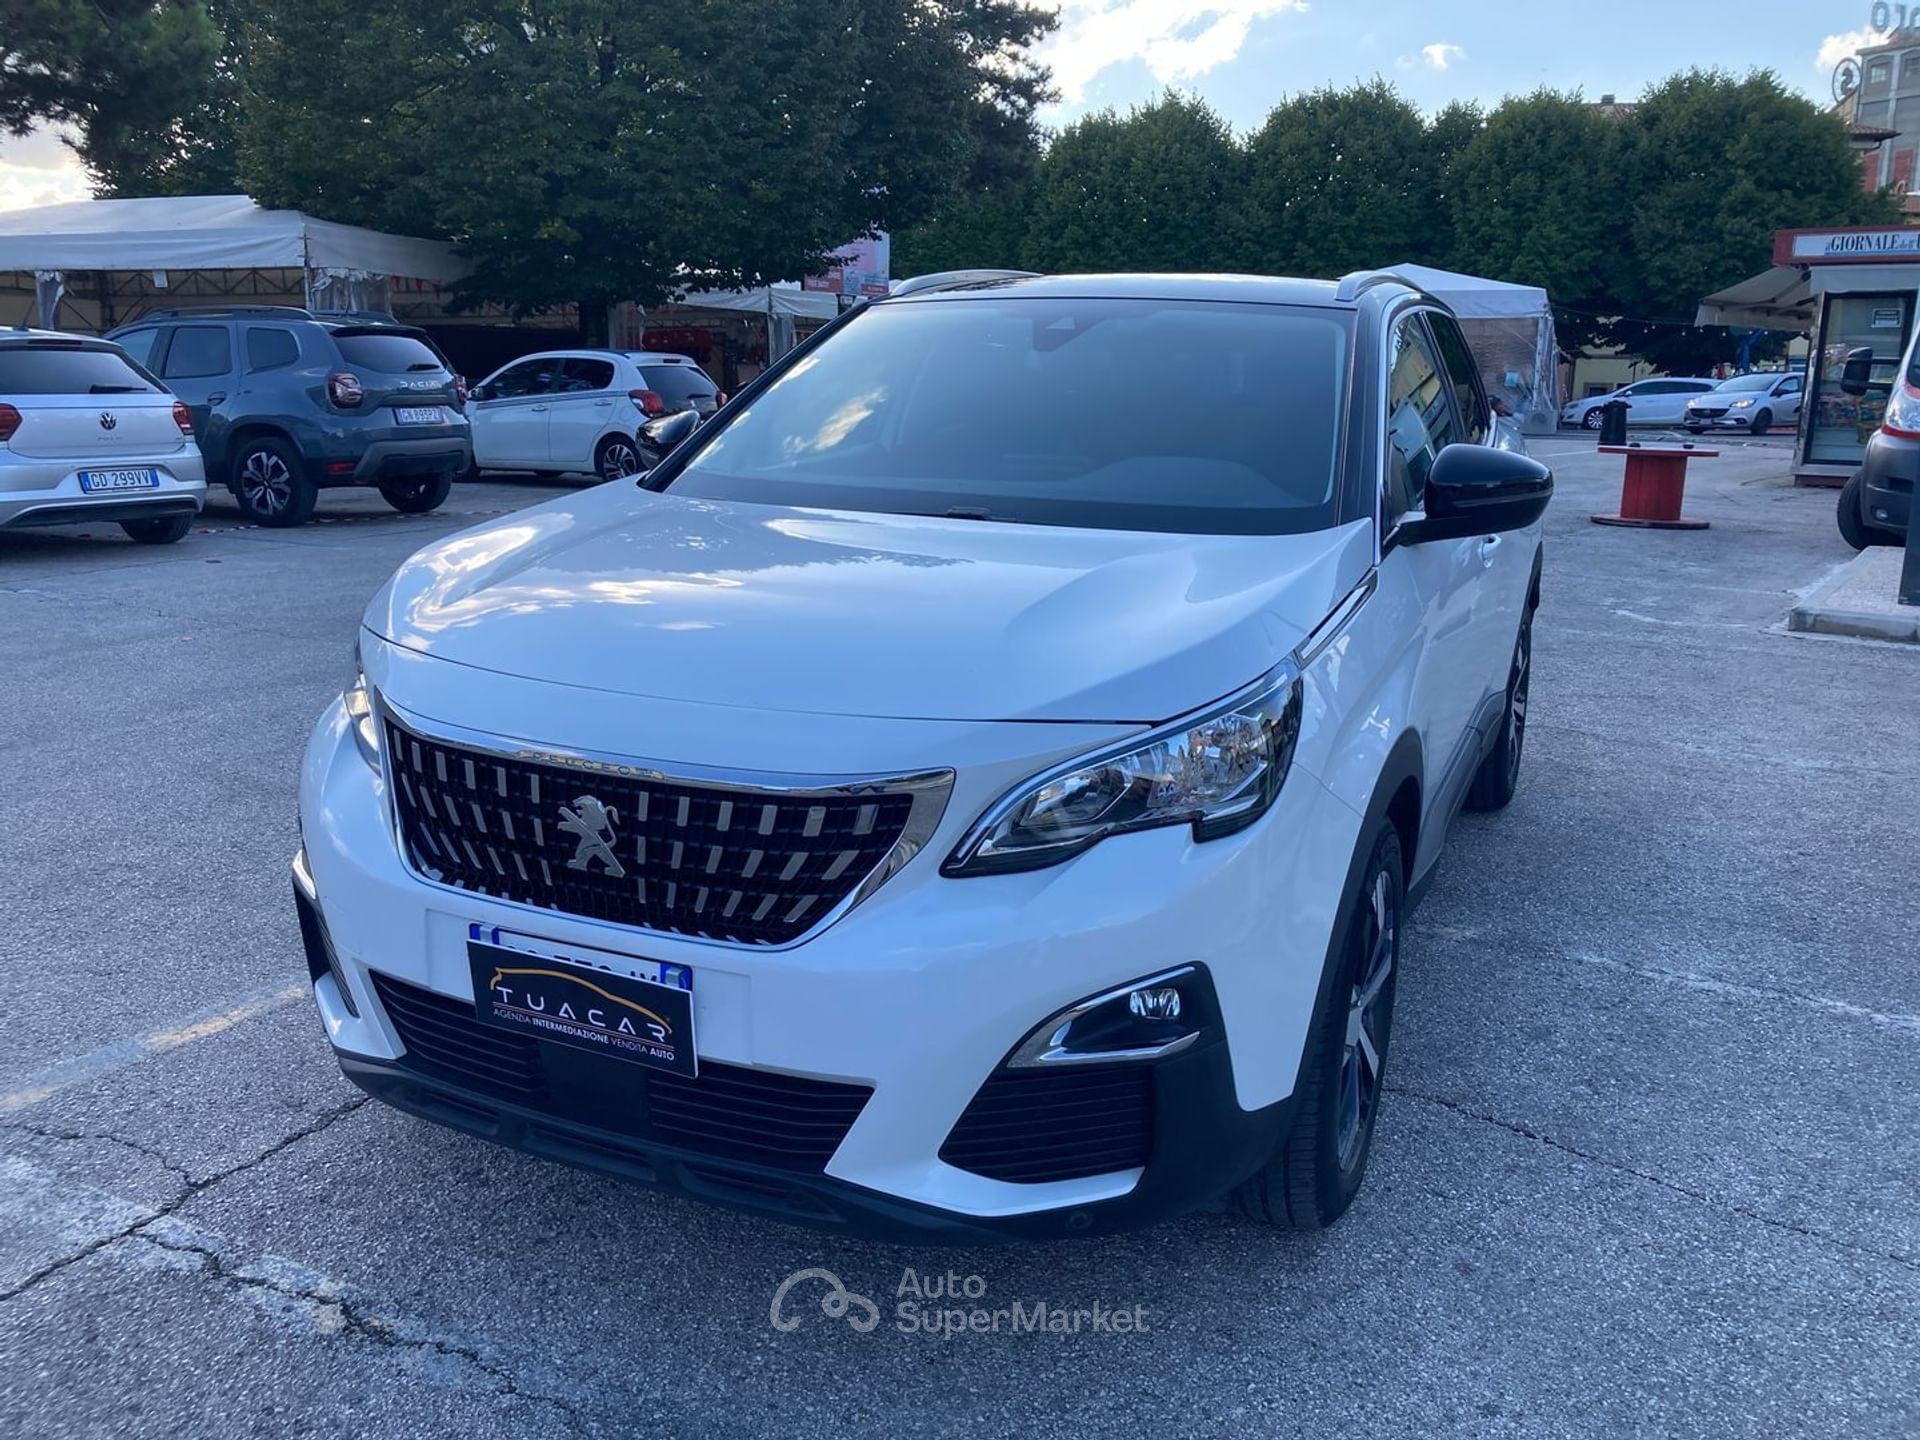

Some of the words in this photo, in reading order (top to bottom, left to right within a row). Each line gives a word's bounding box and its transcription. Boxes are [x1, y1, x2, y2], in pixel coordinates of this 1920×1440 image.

[1831, 233, 1900, 251] GIORNALE
[91, 473, 108, 488] GD
[111, 471, 149, 487] 299VV
[495, 985, 666, 1042] TUACAR
[493, 1008, 531, 1024] AGENZIA
[532, 1017, 609, 1044] INTERMEDIAZIONE
[610, 1036, 648, 1054] VENDITA
[650, 1047, 675, 1061] AUTO
